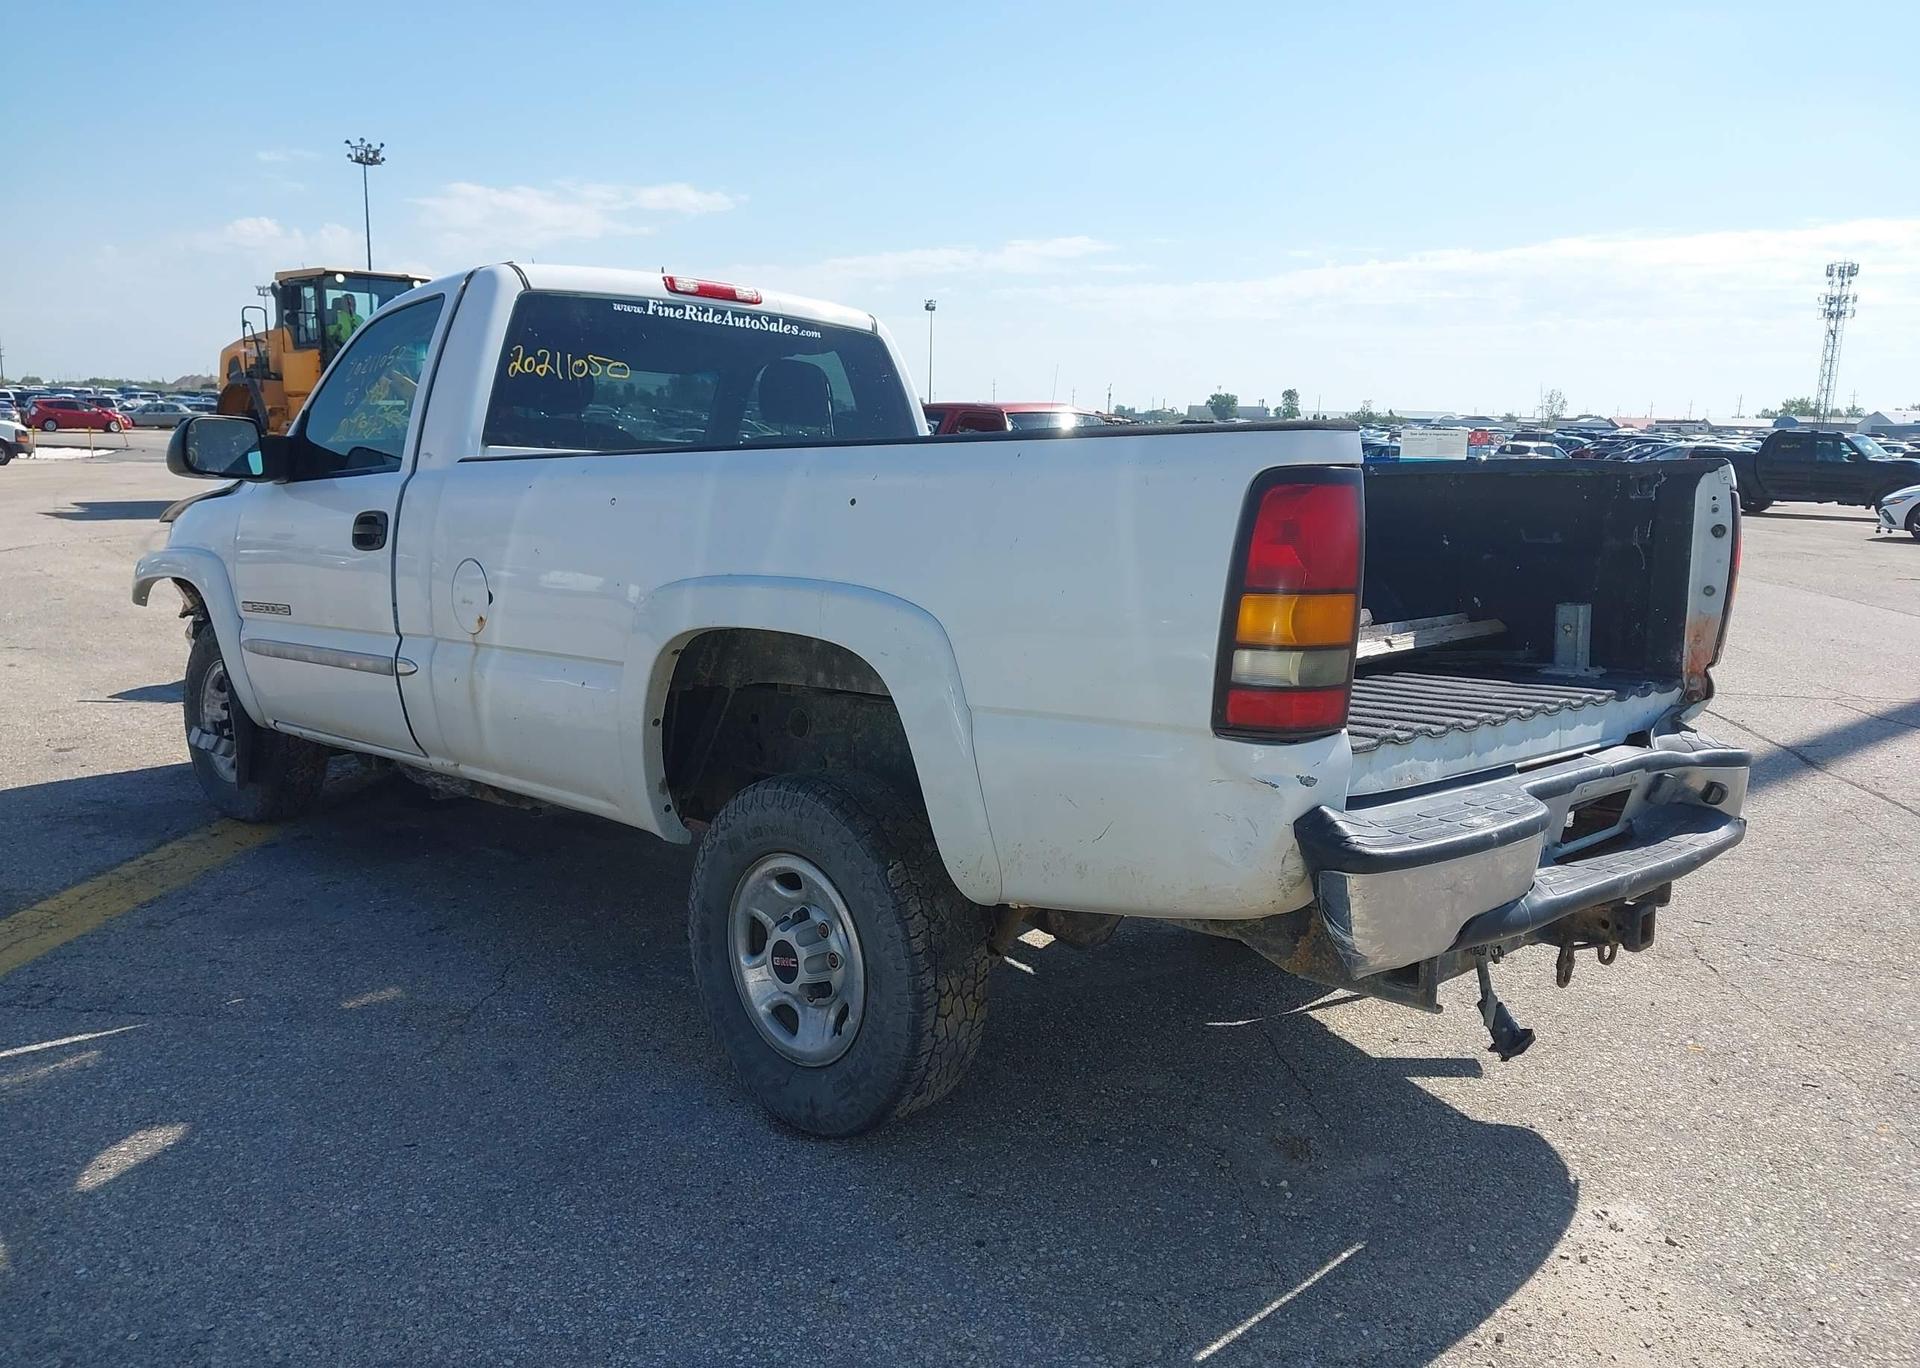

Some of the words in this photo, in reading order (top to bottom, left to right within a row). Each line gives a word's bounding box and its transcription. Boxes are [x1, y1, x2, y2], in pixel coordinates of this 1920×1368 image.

[612, 298, 822, 339] www.FineRideAutoSales.com
[508, 344, 631, 380] 20211050
[773, 956, 798, 967] GMC
